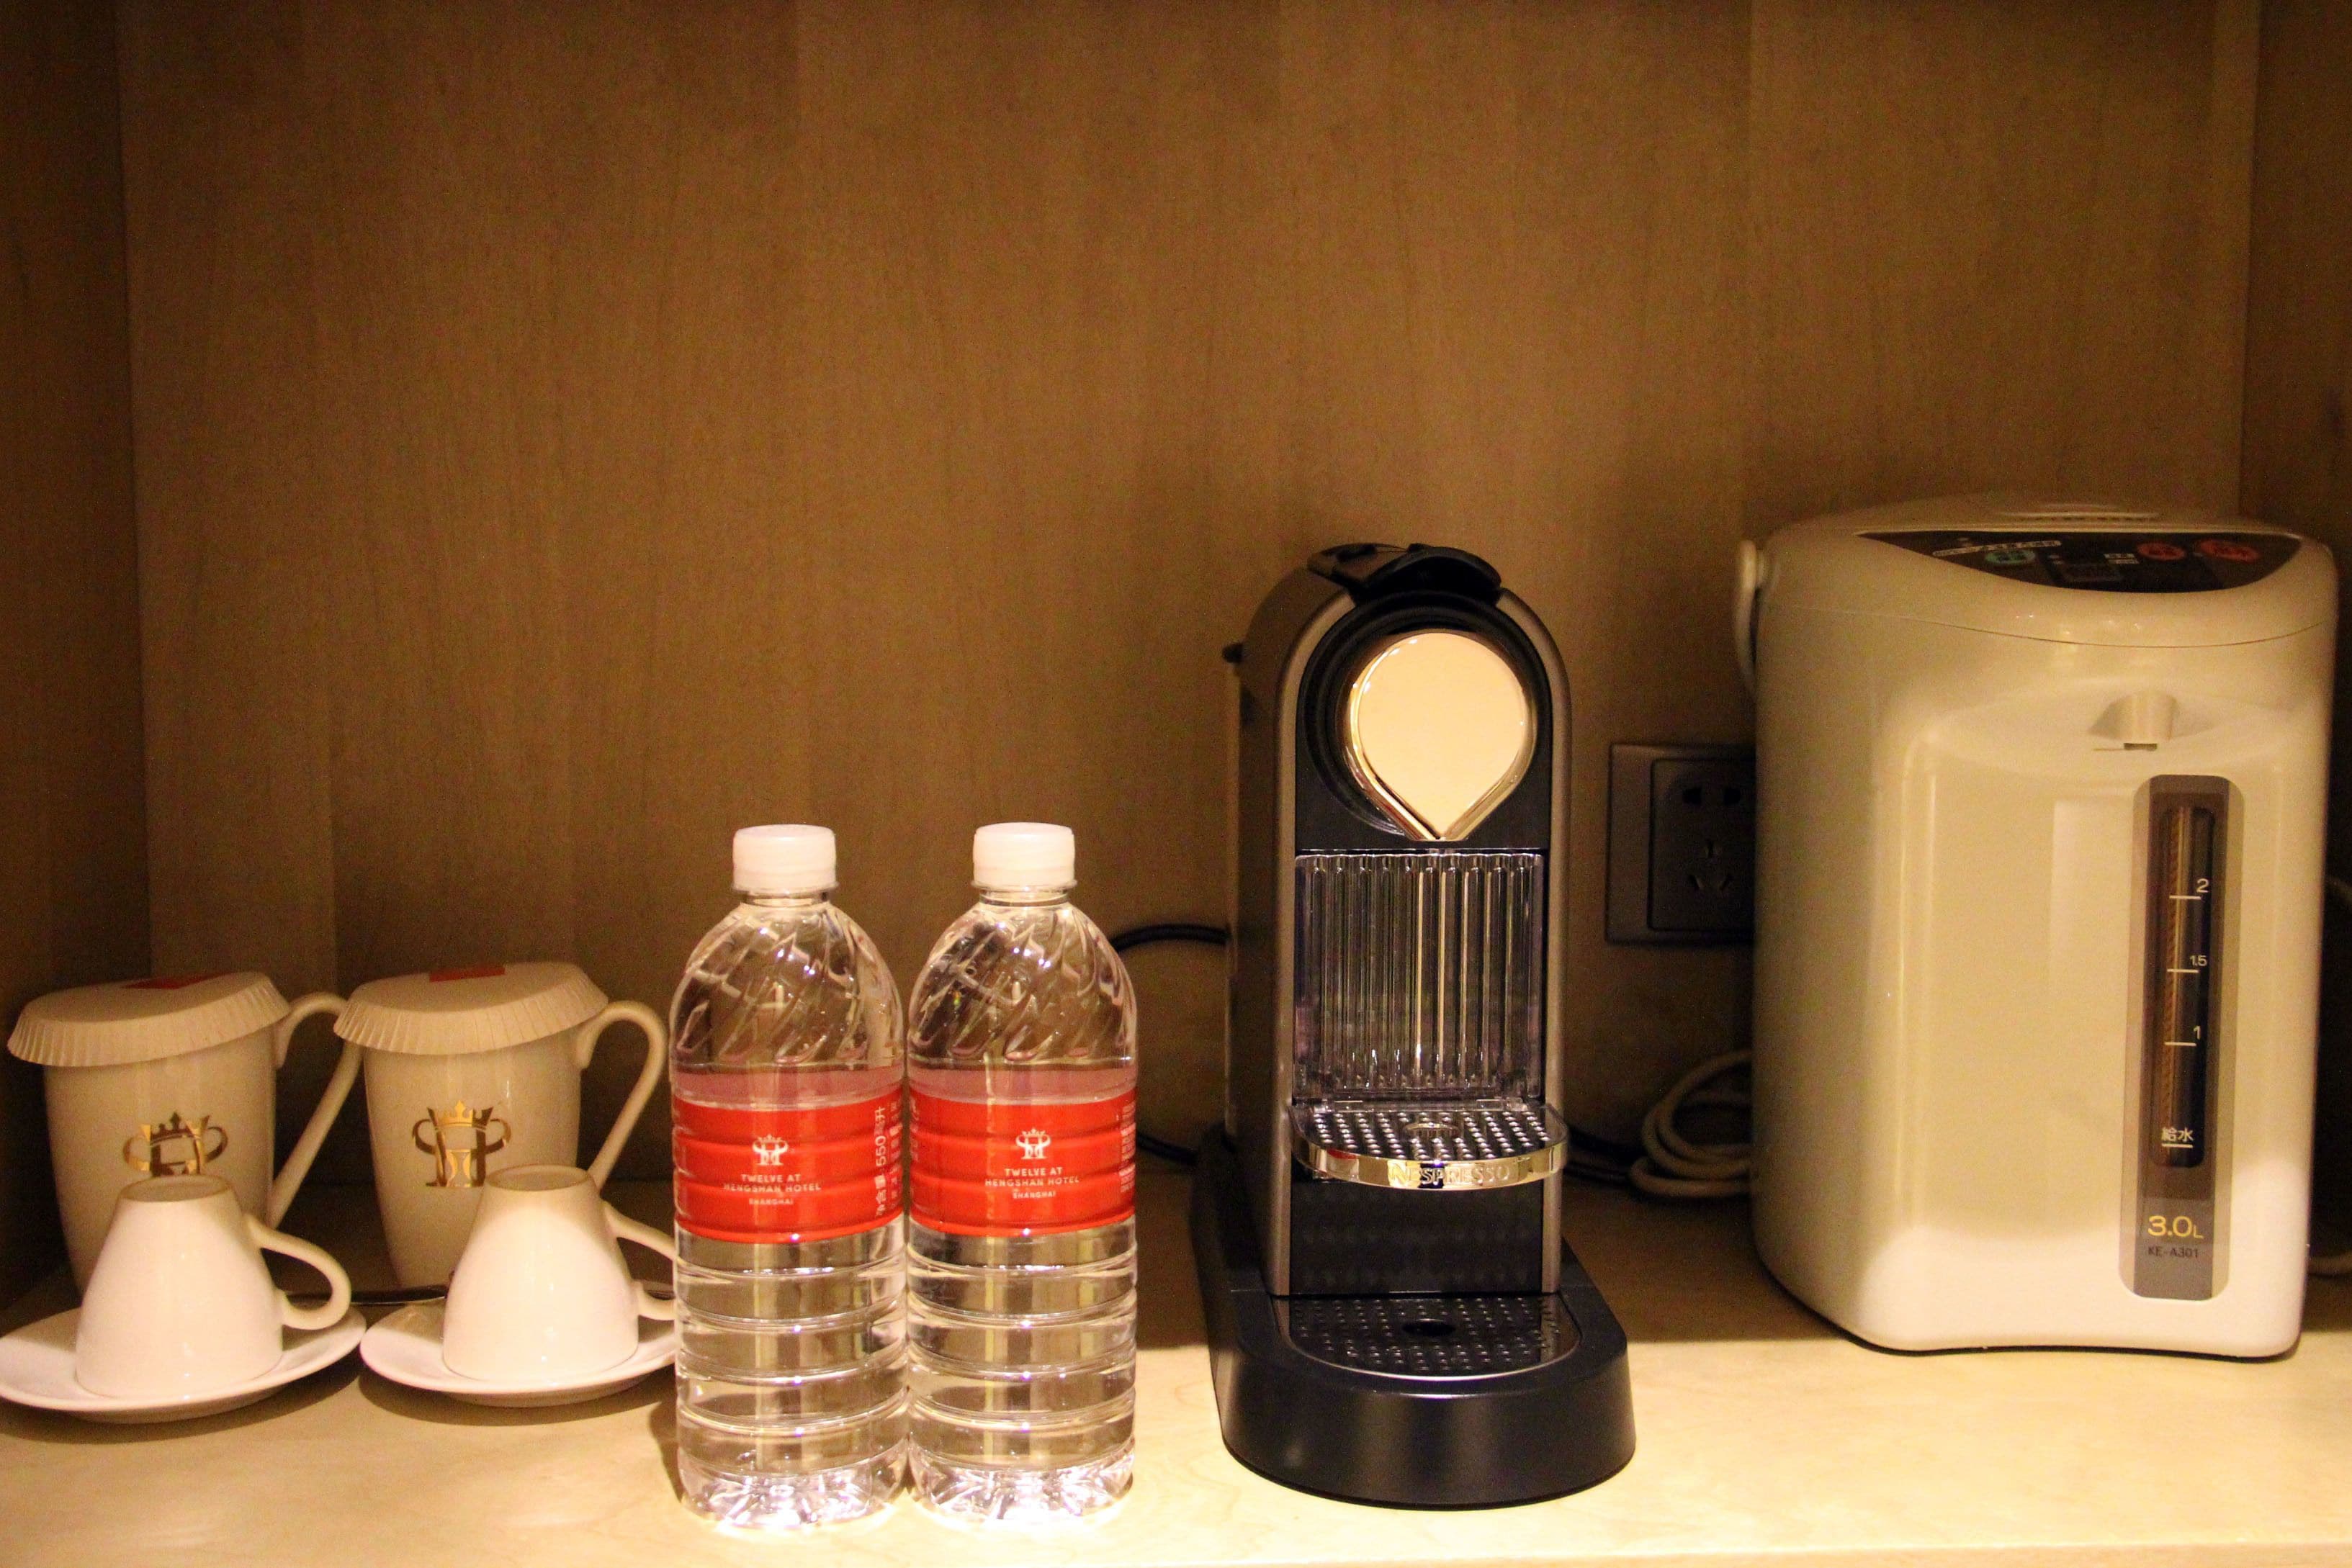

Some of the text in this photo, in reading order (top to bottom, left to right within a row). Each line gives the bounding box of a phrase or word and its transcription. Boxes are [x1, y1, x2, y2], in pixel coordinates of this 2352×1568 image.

[2196, 878, 2209, 893] 2
[2193, 1025, 2201, 1040] 1
[2161, 1127, 2194, 1142] 給水
[1005, 1168, 1046, 1176] TWELVE
[740, 1174, 783, 1183] TWELVE
[1048, 1176, 1080, 1185] HOTEL
[785, 1182, 822, 1192] HOTEL
